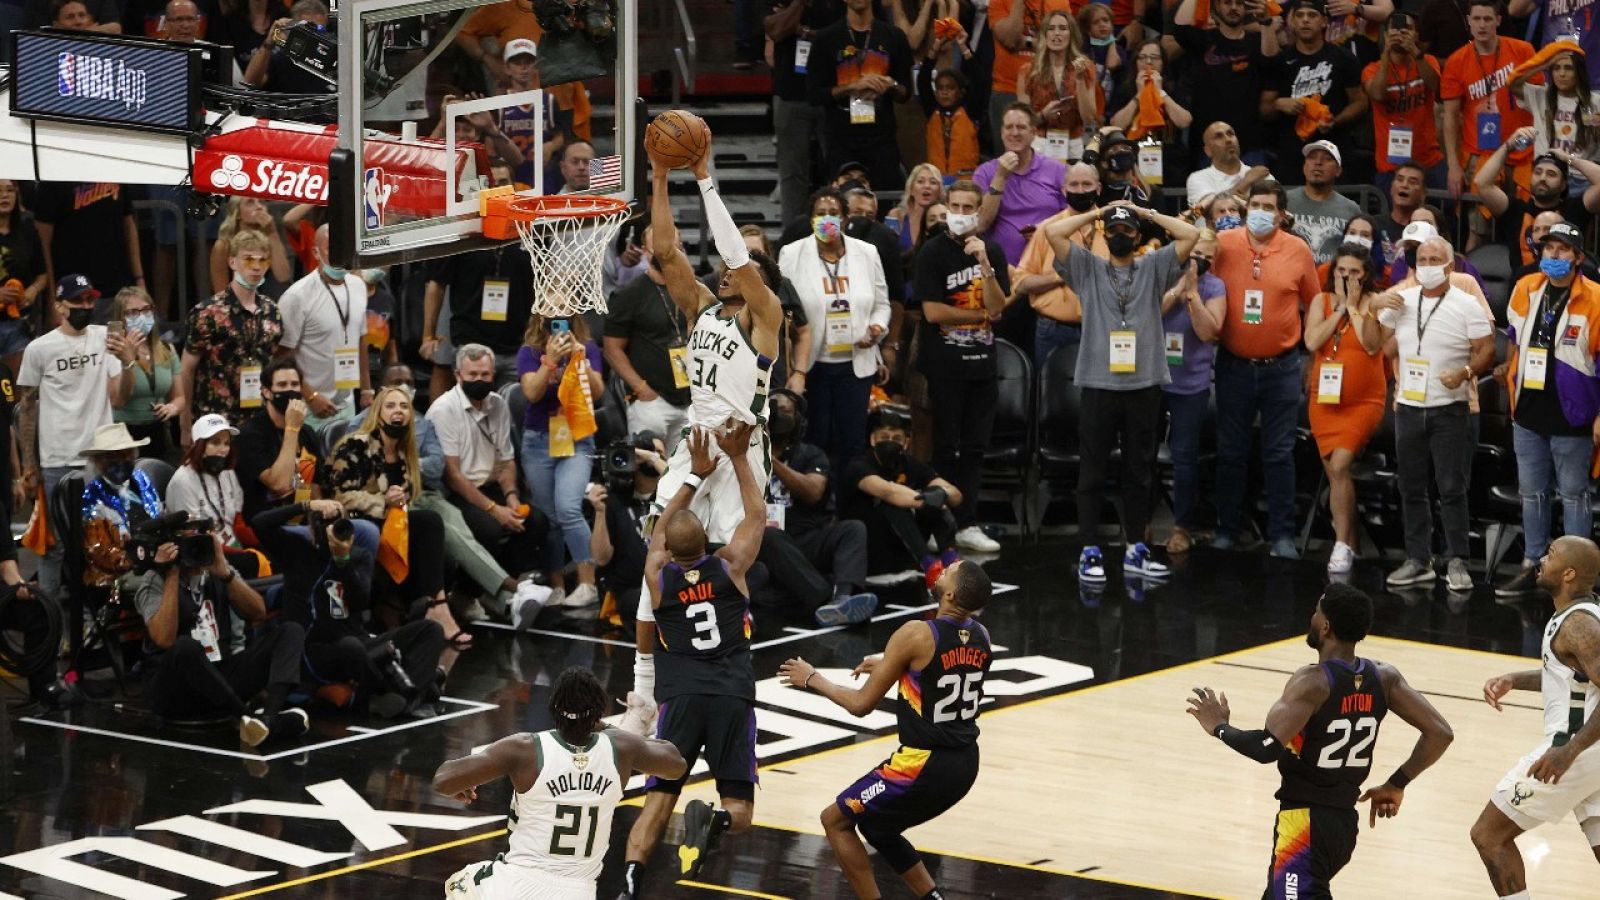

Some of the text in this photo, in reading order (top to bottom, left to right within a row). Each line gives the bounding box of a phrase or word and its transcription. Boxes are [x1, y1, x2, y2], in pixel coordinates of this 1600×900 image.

[76, 56, 146, 111] NBA App
[1468, 62, 1514, 101] PHNIX
[251, 160, 323, 200] State
[56, 353, 102, 371] DEPT.
[692, 330, 739, 360] BUCKS
[692, 357, 718, 393] 34
[678, 582, 715, 605] PAUL
[686, 602, 721, 650] 3
[941, 647, 988, 670] BRIDGES
[934, 671, 984, 724] 25
[1341, 693, 1374, 714] AYTON
[1317, 717, 1377, 768] 22
[546, 772, 613, 797] HOLIDAY
[550, 804, 599, 857] 21
